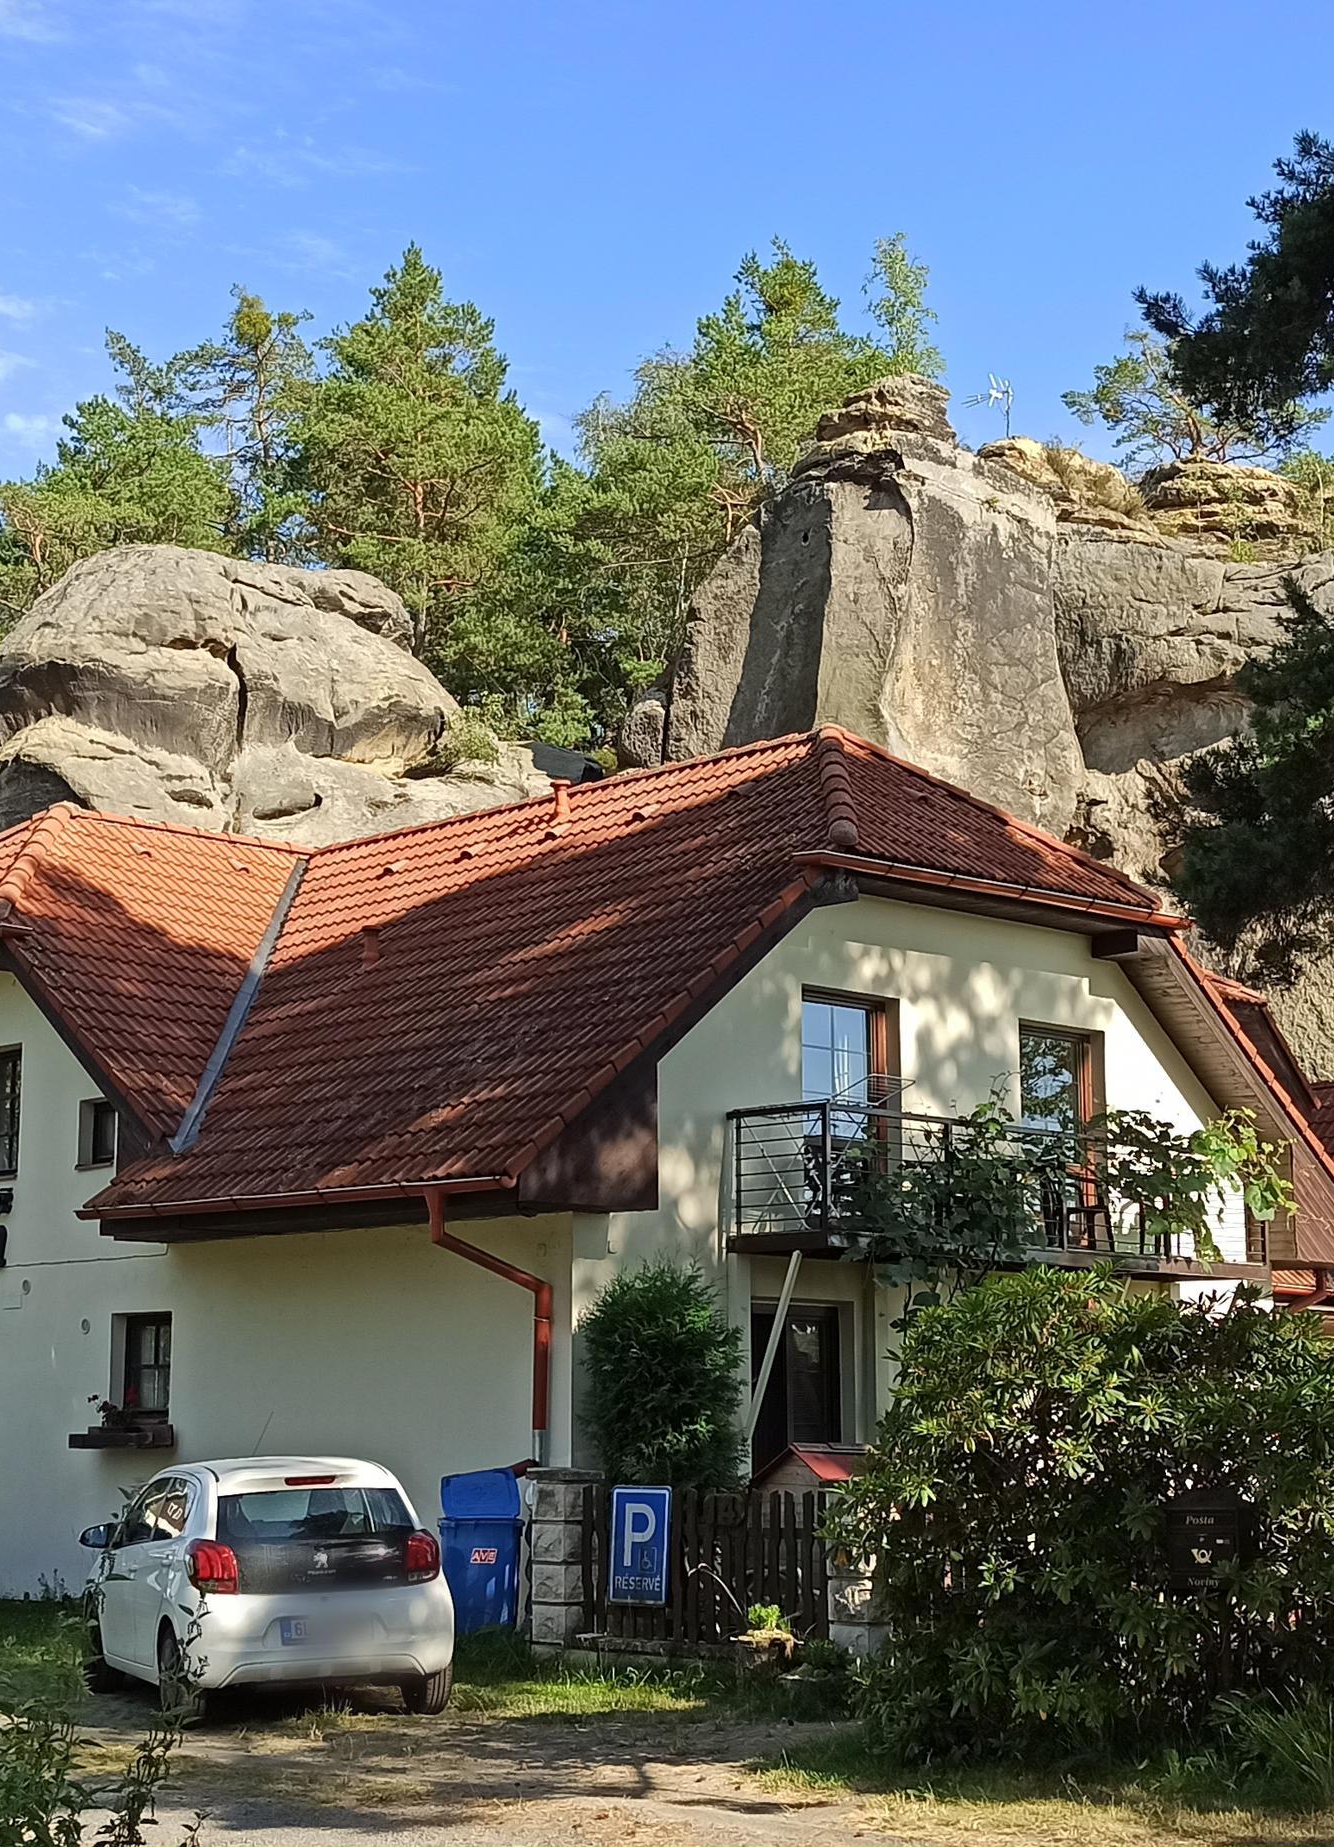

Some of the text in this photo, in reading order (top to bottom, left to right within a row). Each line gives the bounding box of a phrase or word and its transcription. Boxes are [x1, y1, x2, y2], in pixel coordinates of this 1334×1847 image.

[623, 1503, 656, 1567] P
[471, 1550, 496, 1562] AVE
[615, 1573, 662, 1592] RÉSERVÉ
